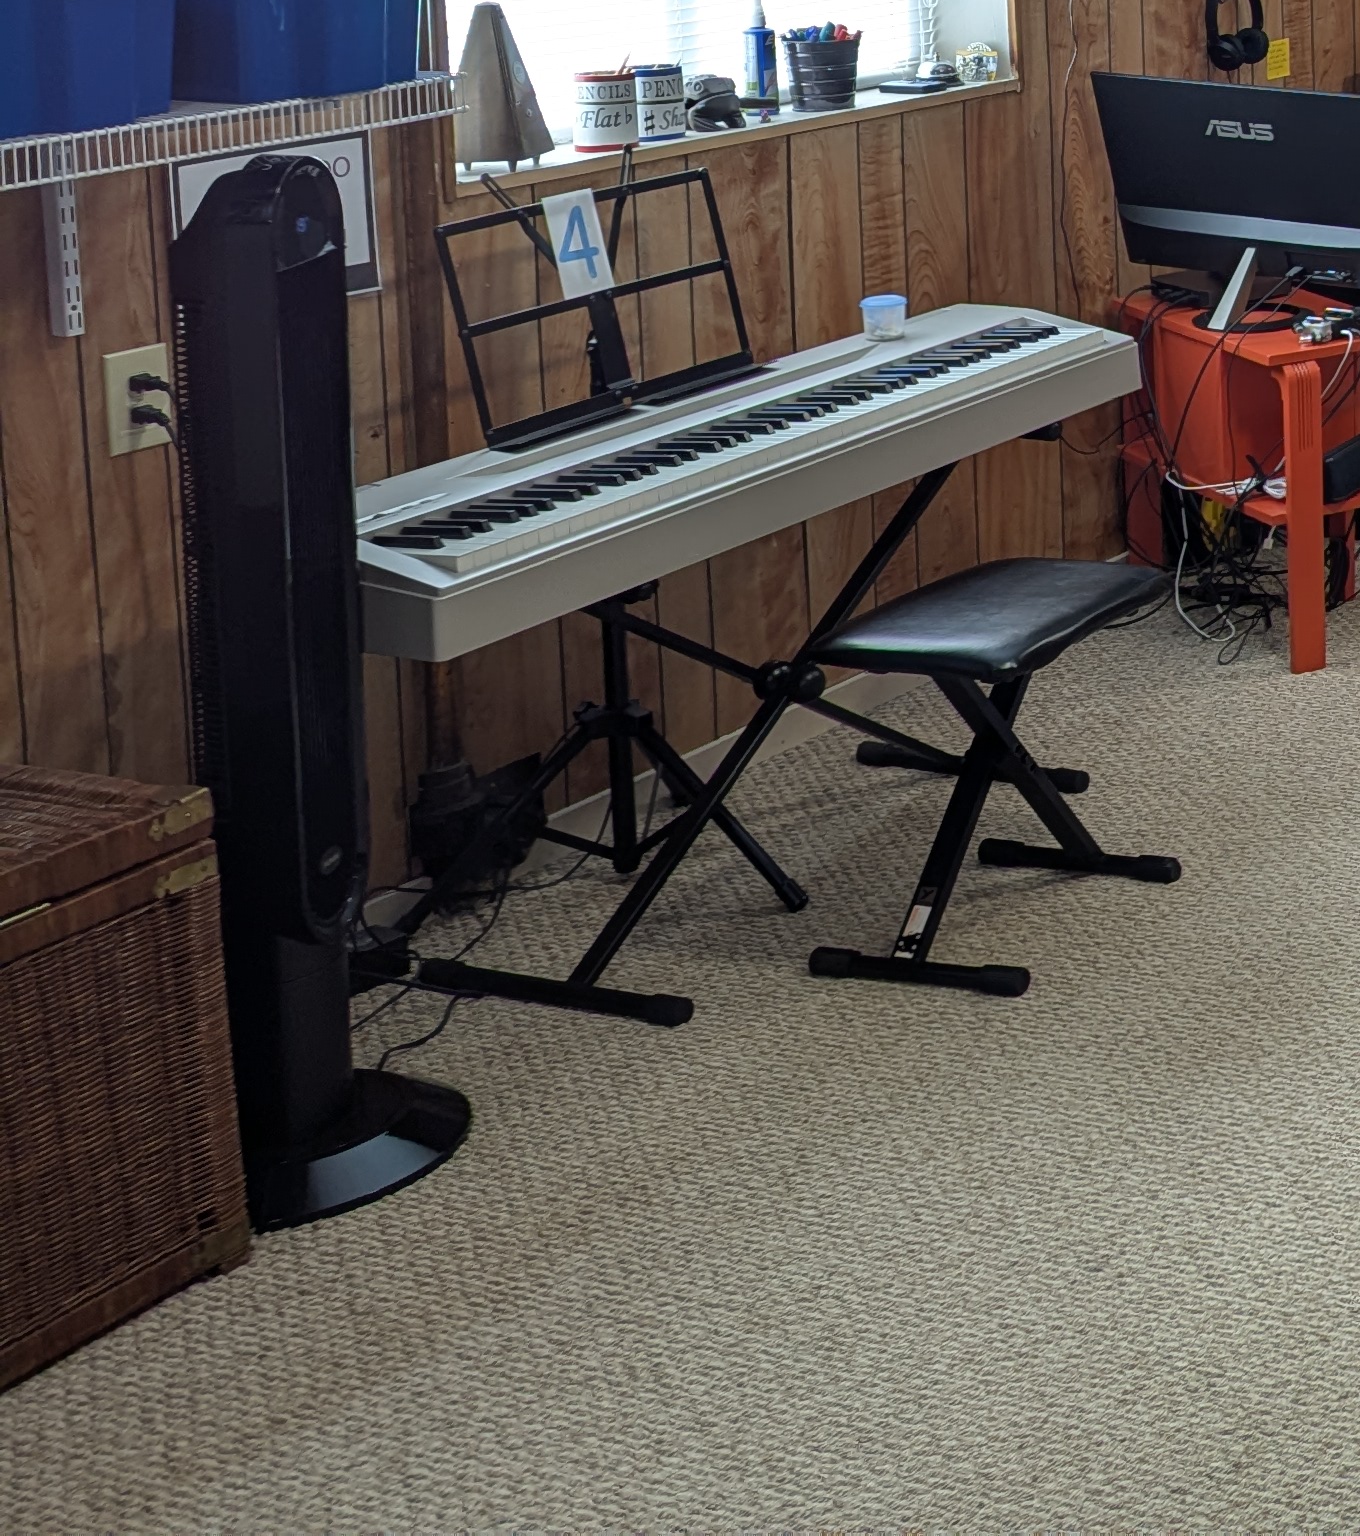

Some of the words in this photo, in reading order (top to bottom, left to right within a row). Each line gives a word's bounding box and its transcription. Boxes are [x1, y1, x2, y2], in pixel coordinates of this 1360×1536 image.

[577, 83, 631, 100] ENCILS
[580, 106, 622, 129] Flat
[1205, 119, 1274, 142] ASUS
[557, 204, 602, 281] 4
